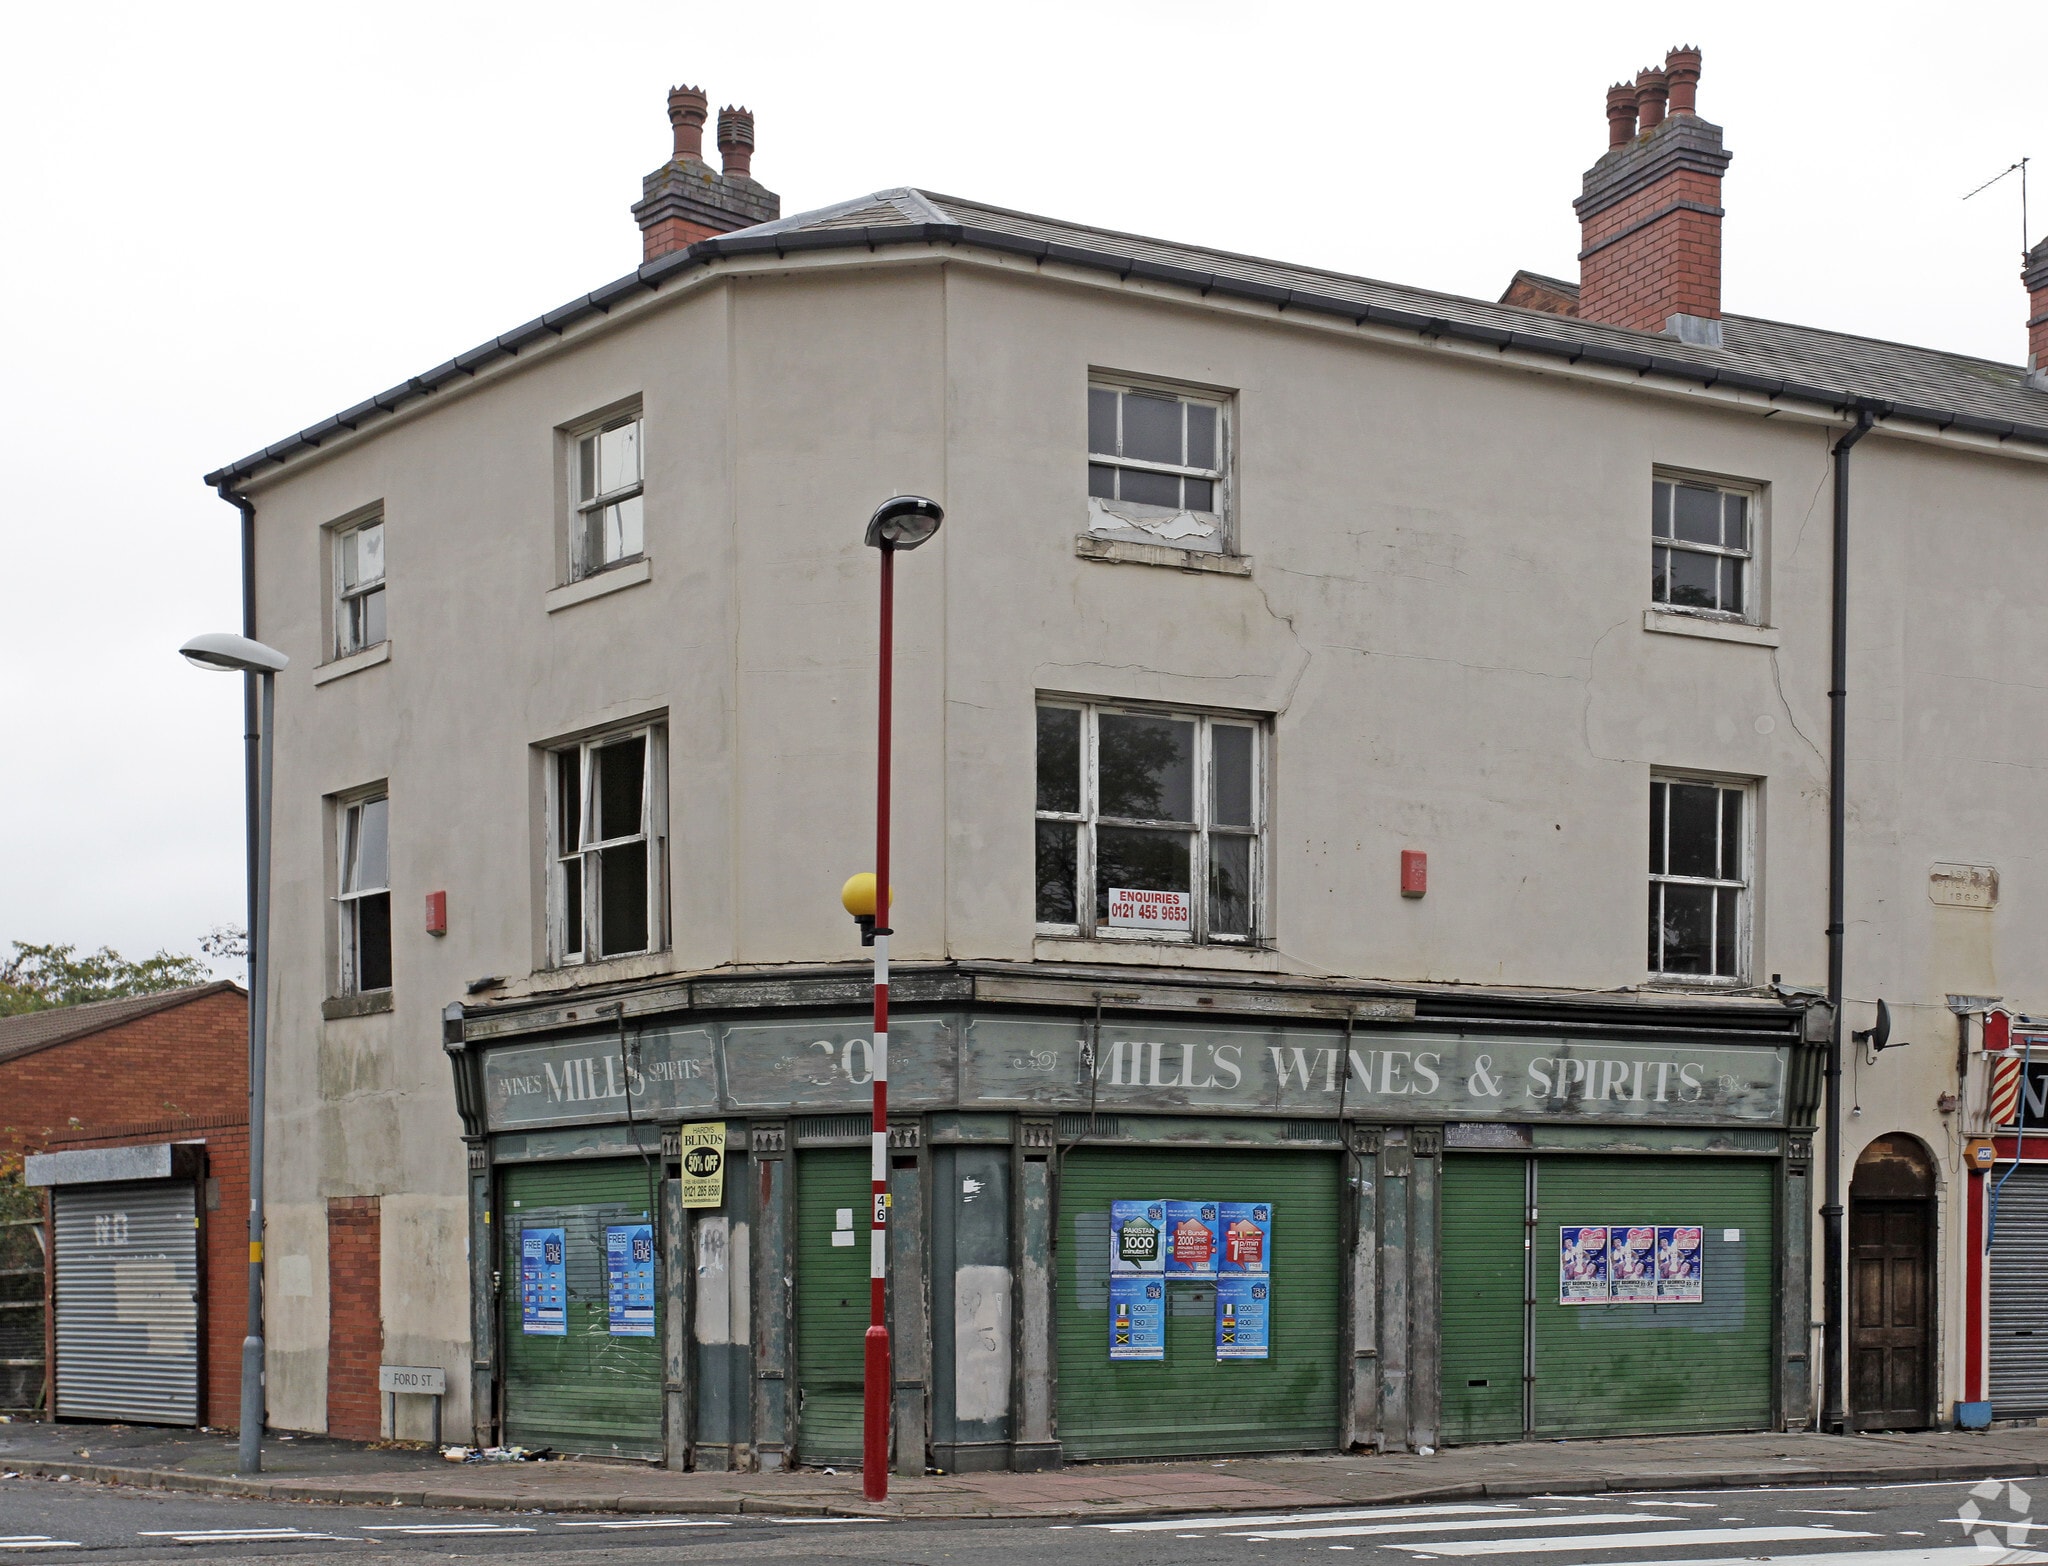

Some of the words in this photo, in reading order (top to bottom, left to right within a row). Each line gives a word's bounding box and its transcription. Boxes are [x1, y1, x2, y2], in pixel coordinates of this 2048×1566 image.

[1120, 891, 1180, 904] ENQUIRIES
[1112, 903, 1134, 918] 0121
[1139, 904, 1158, 919] 455
[1161, 906, 1187, 921] 9653
[500, 1075, 542, 1096] WINES
[648, 1059, 703, 1082] SPIRITS
[1075, 1040, 1242, 1090] MILL'S
[1267, 1046, 1441, 1096] WINES
[1468, 1054, 1503, 1098] &
[1526, 1057, 1705, 1103] SPIRITS
[685, 1134, 724, 1146] BLINDS
[688, 1156, 704, 1172] 50%
[704, 1155, 718, 1171] OFF
[525, 1240, 541, 1249] FREE
[608, 1234, 626, 1243] FREE
[1124, 1237, 1154, 1249] 1000
[1177, 1236, 1195, 1246] 2000
[546, 1243, 561, 1252] TALK
[633, 1240, 650, 1250] TALK
[1231, 1240, 1239, 1260] 1
[546, 1252, 561, 1262] HOME
[633, 1249, 650, 1259] HOME
[394, 1373, 418, 1386] FORD
[421, 1374, 433, 1387] ST.
